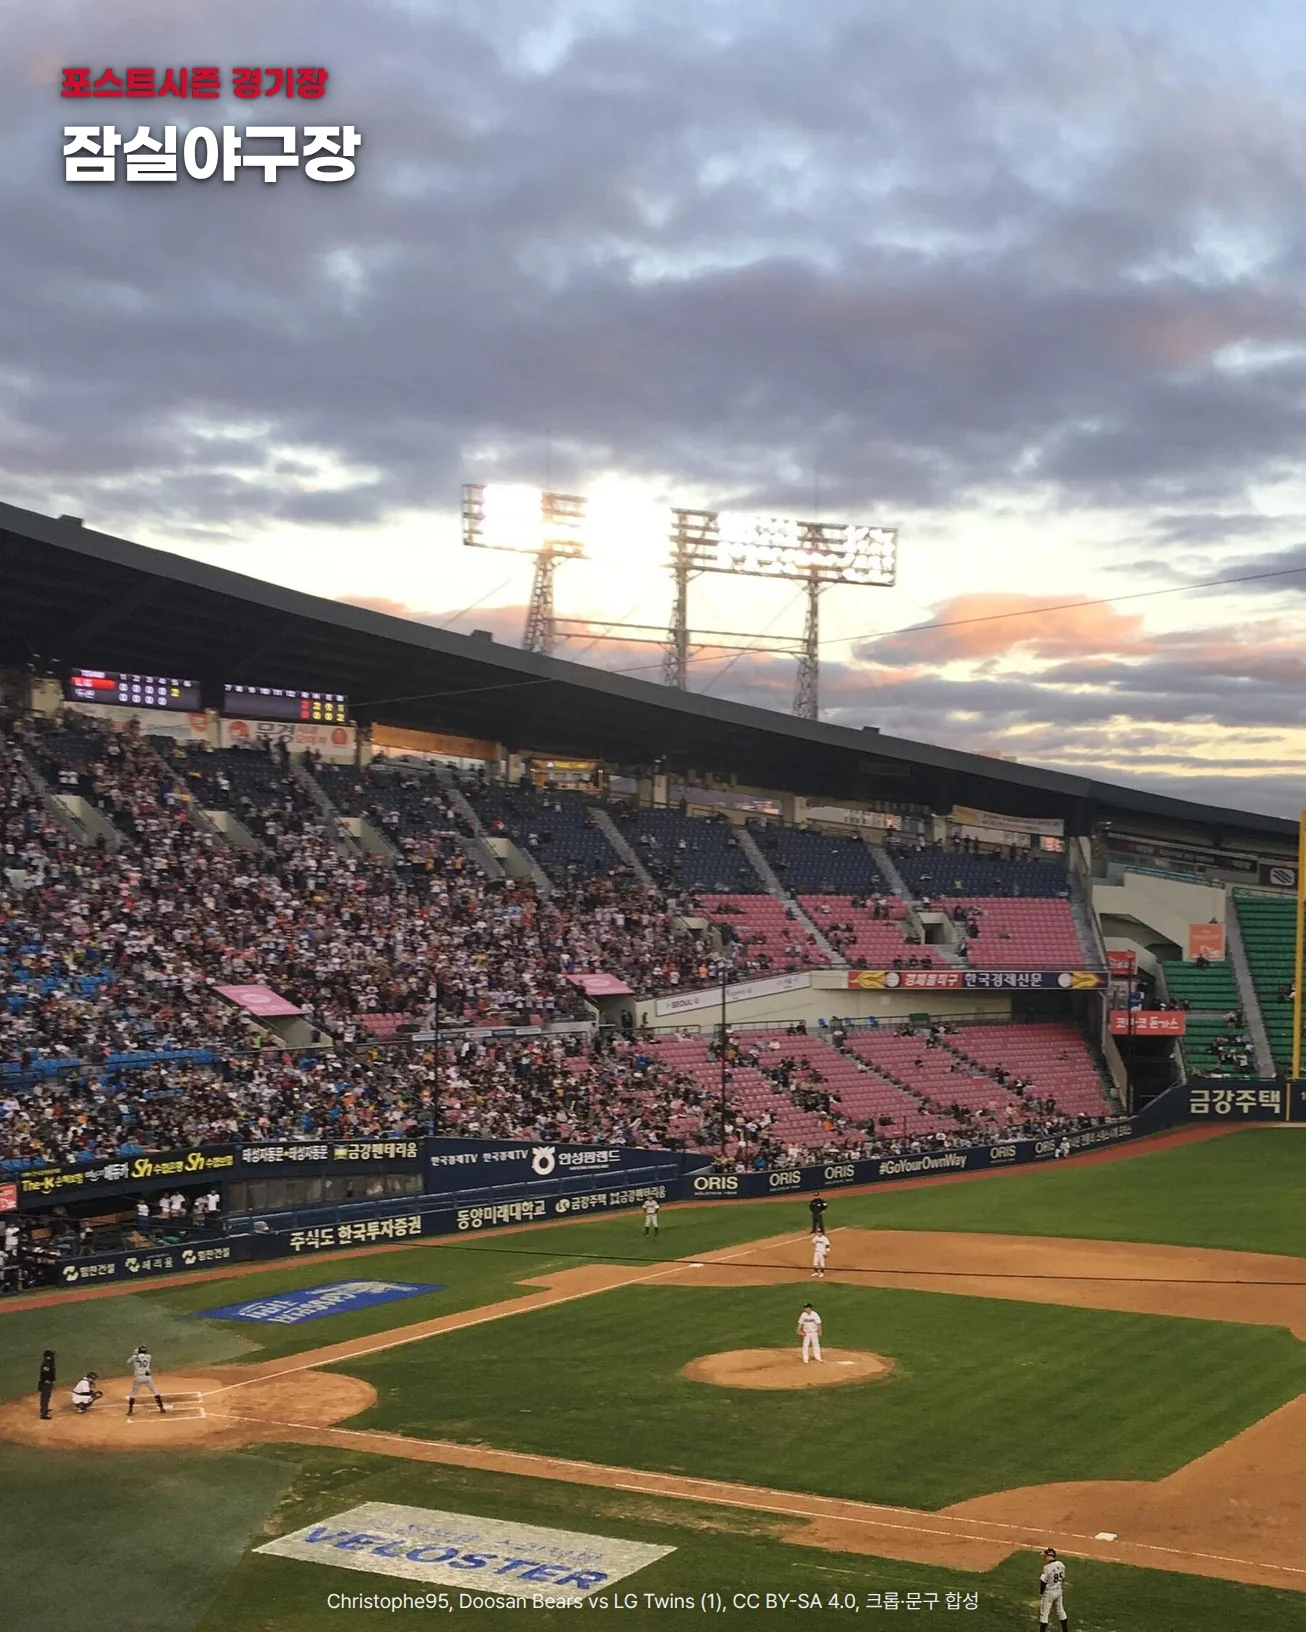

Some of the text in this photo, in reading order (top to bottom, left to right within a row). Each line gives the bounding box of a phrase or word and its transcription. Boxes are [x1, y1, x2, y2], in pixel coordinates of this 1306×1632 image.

[965, 972, 1045, 989] 한국경제신문
[1189, 1089, 1281, 1115] 금강주택
[348, 1142, 418, 1160] 금강펜테리움
[559, 1149, 621, 1167] 안성팜랜드
[990, 1143, 1018, 1160] ORIS
[131, 1158, 153, 1178] Sh
[185, 1151, 204, 1172] Sh
[879, 1154, 968, 1176] #GoYourOwnWay
[769, 1170, 802, 1187] ORIS
[825, 1164, 856, 1180] ORIS
[693, 1176, 739, 1190] ORIS
[572, 1194, 607, 1211] 금강주택
[457, 1200, 547, 1231] 동양미래대학교
[290, 1215, 422, 1252] 주식도 한국투자증권
[304, 1526, 610, 1591] VELOSTER
